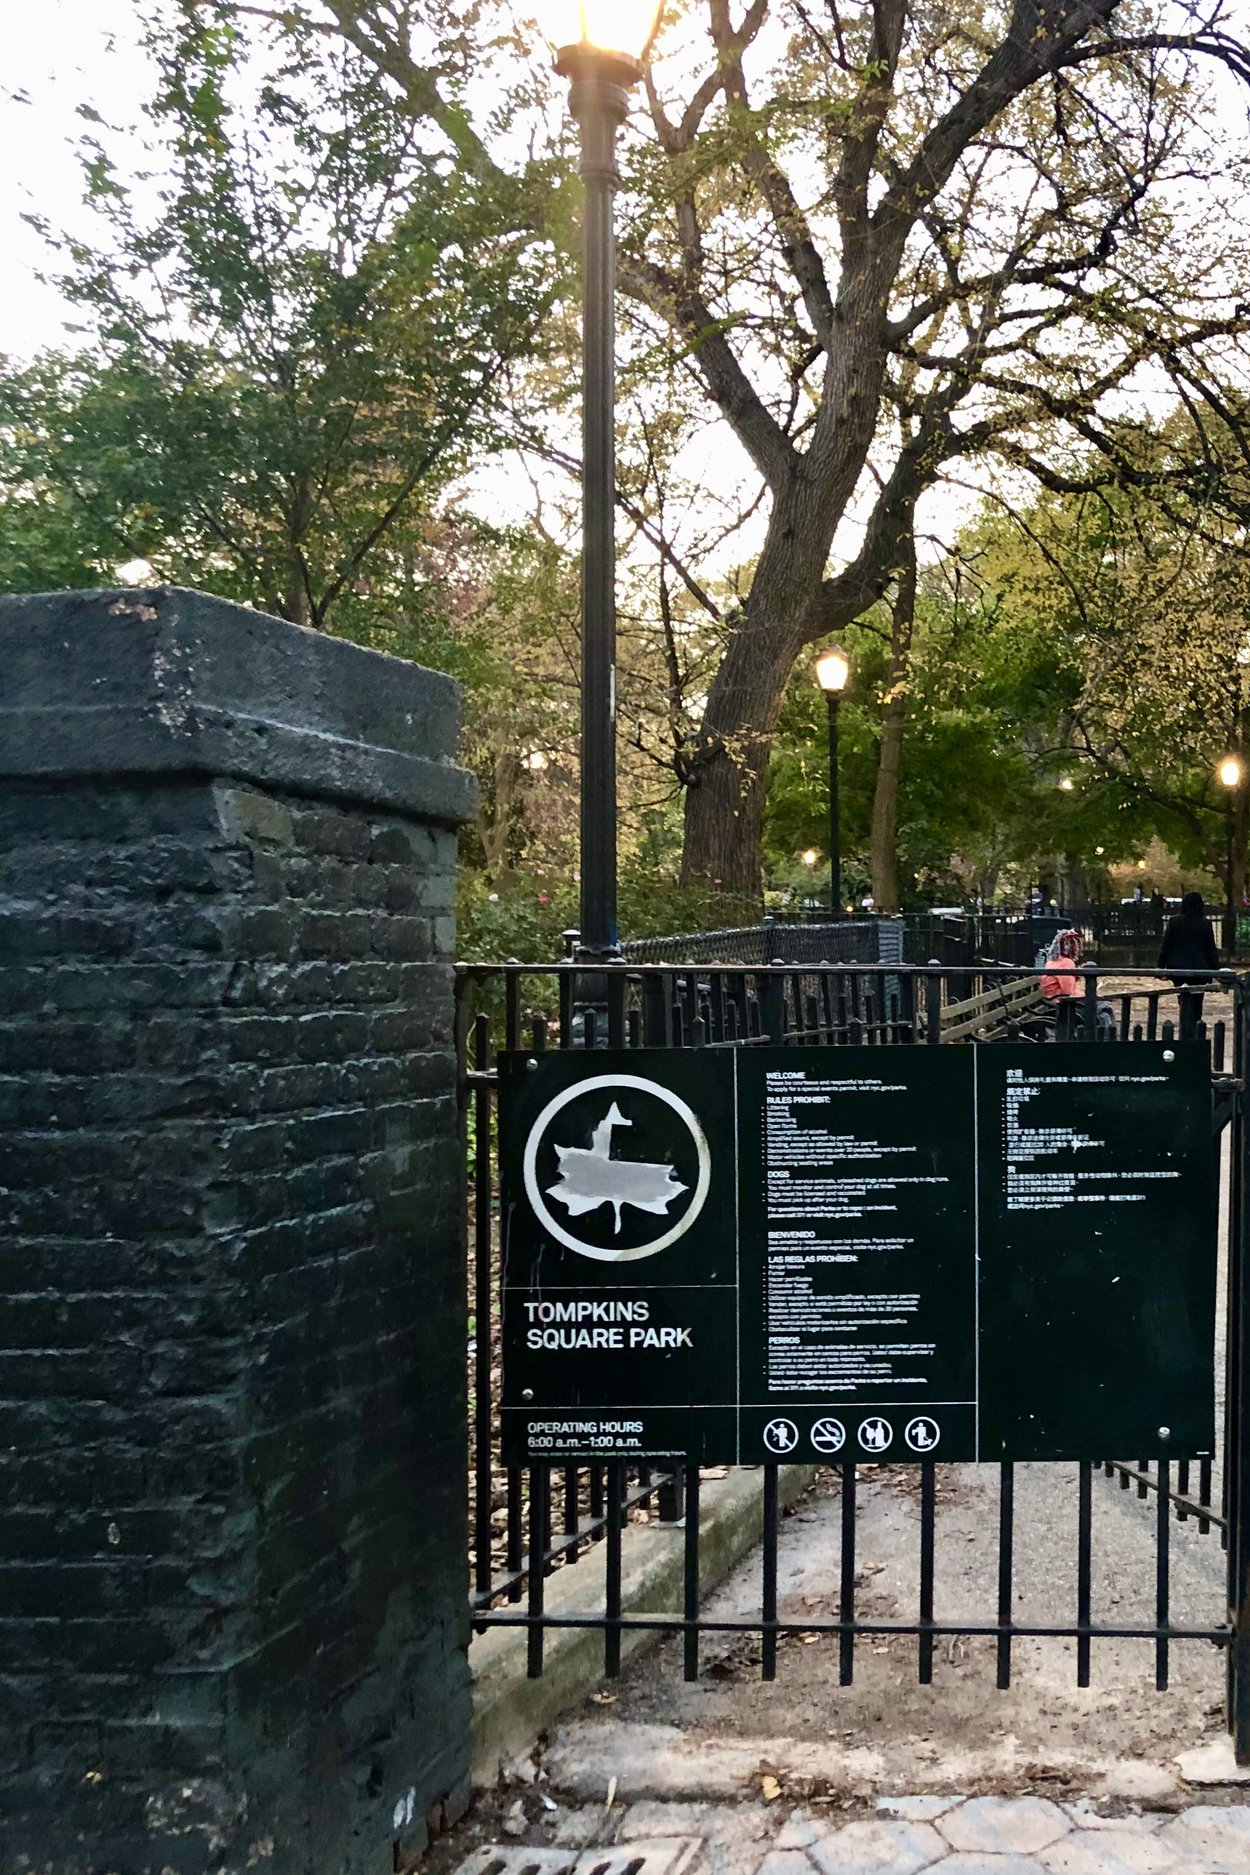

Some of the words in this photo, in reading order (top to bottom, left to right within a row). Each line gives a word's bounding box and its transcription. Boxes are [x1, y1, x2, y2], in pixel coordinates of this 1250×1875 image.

[766, 1071, 806, 1079] WELCOME
[766, 1096, 793, 1104] RULES
[768, 1255, 783, 1263] LAS
[785, 1255, 815, 1263] REGLAS
[817, 1254, 859, 1263] PROHÍBEN:
[523, 1301, 649, 1322] TOMPKINS
[526, 1327, 624, 1350] SQUARE
[630, 1327, 693, 1348] PARK
[768, 1336, 801, 1344] PERROS
[527, 1421, 597, 1433] OPERATING
[600, 1421, 644, 1433] HOURS
[527, 1436, 553, 1447] 6:00
[616, 1436, 642, 1447] a.m.
